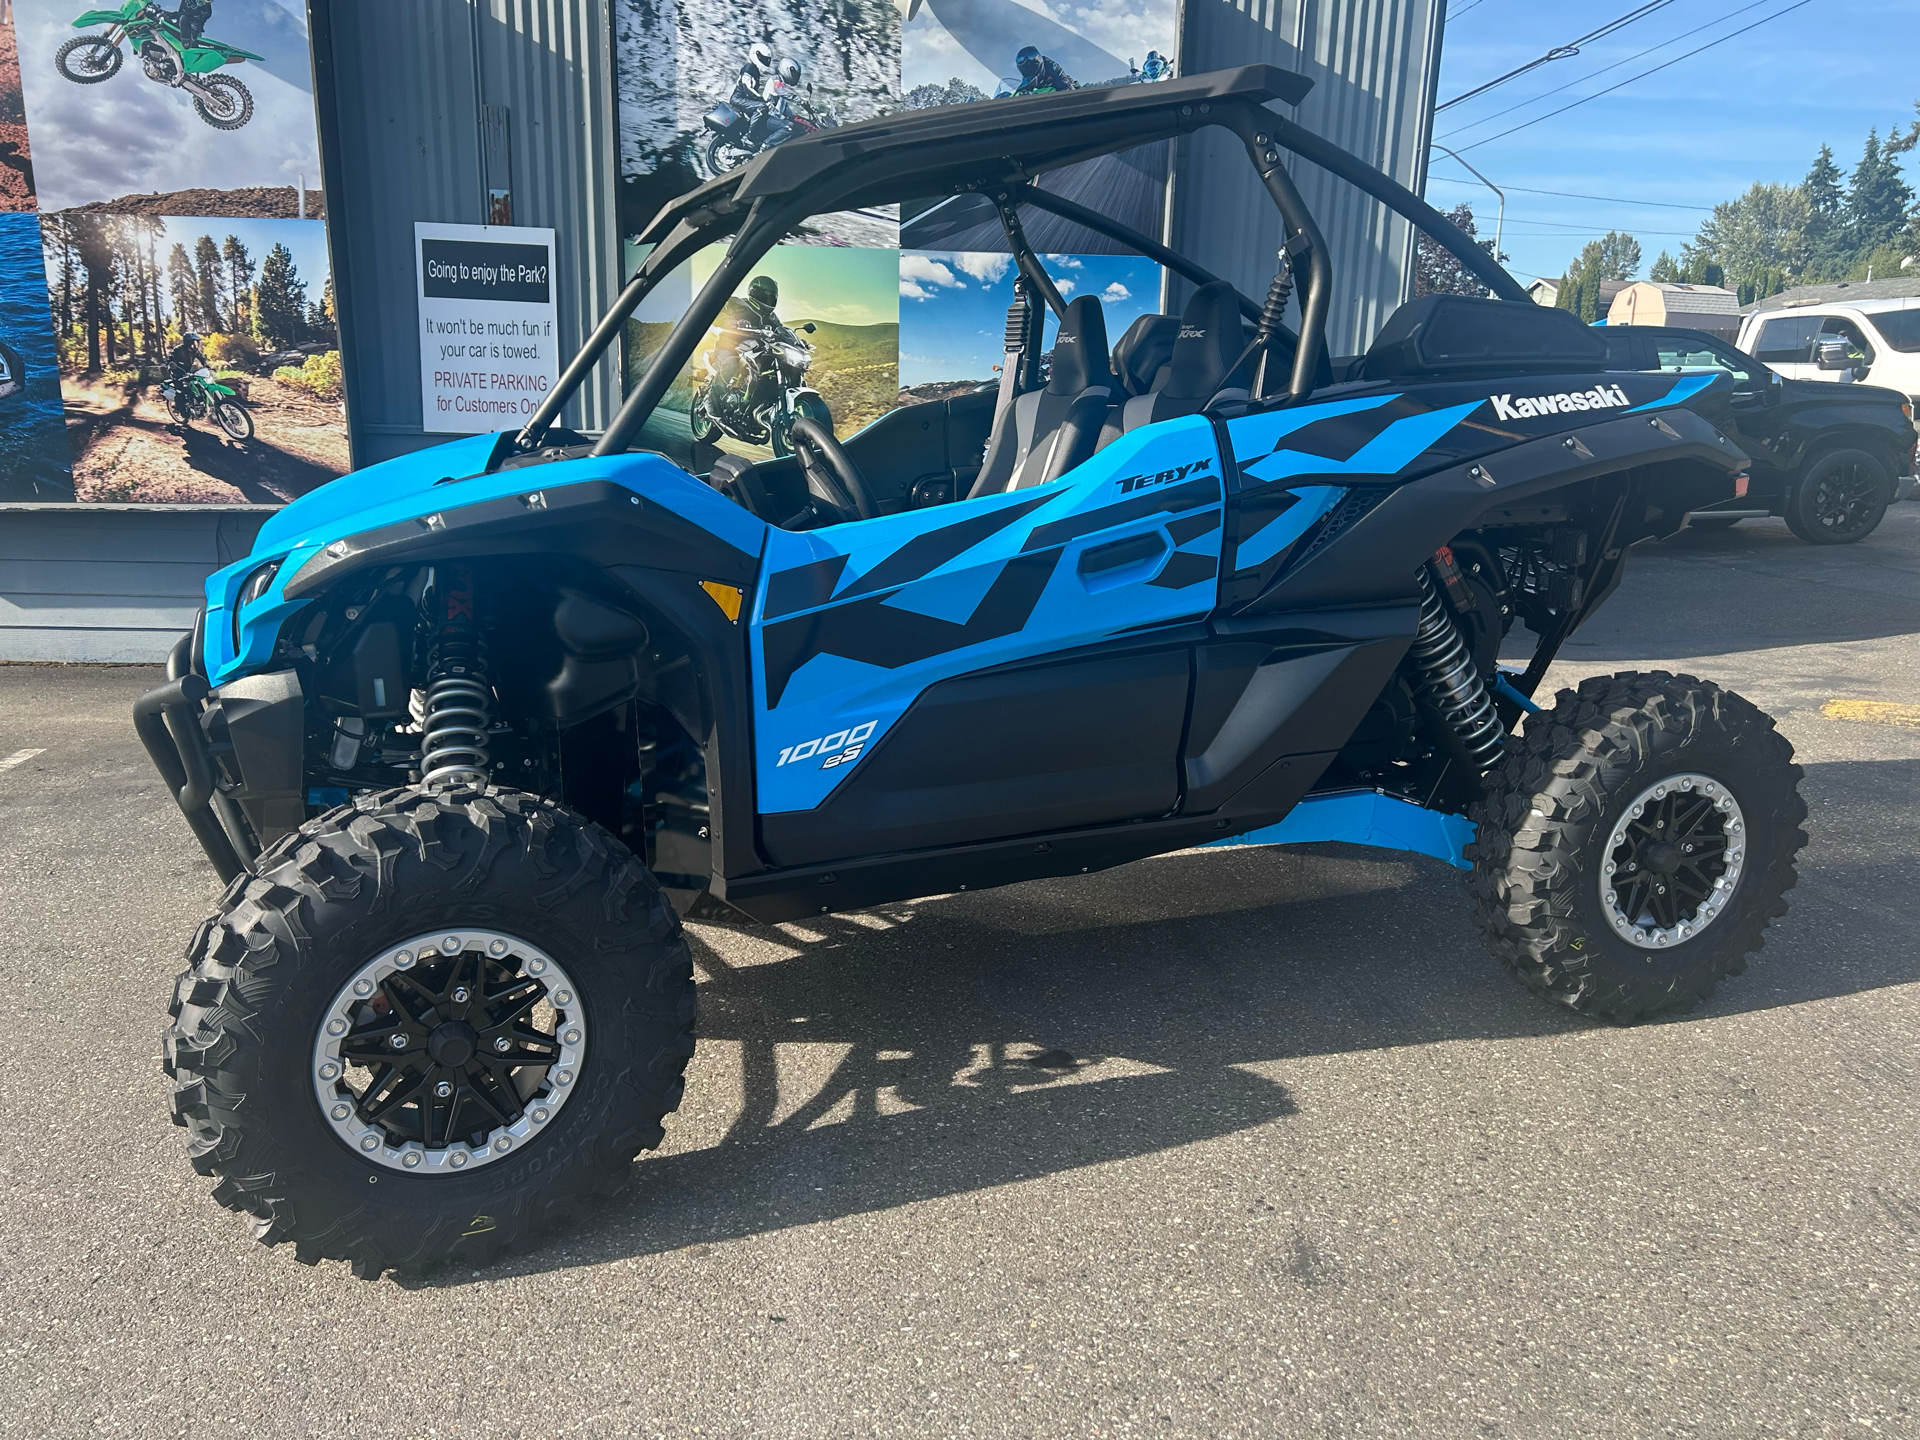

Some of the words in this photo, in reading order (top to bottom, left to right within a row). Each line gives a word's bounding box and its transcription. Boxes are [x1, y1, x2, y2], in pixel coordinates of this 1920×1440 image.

[428, 260, 457, 283] Going
[460, 262, 469, 279] to
[472, 266, 498, 285] enjoy
[500, 264, 515, 282] the
[518, 264, 546, 283] Park?
[426, 318, 434, 333] It
[436, 319, 466, 334] won't
[469, 320, 484, 335] be
[488, 320, 519, 336] much
[522, 320, 539, 336] fun
[544, 321, 551, 336] if
[440, 345, 465, 360] your
[469, 345, 486, 357] car
[490, 345, 499, 358] is
[503, 345, 540, 359] towed.
[434, 371, 487, 389] PRIVATE
[491, 373, 547, 391] PARKING
[437, 396, 451, 411] for
[455, 396, 517, 413] Customers
[520, 398, 540, 414] Onl
[1490, 384, 1630, 421] Kawasaki
[775, 719, 879, 768] 1000
